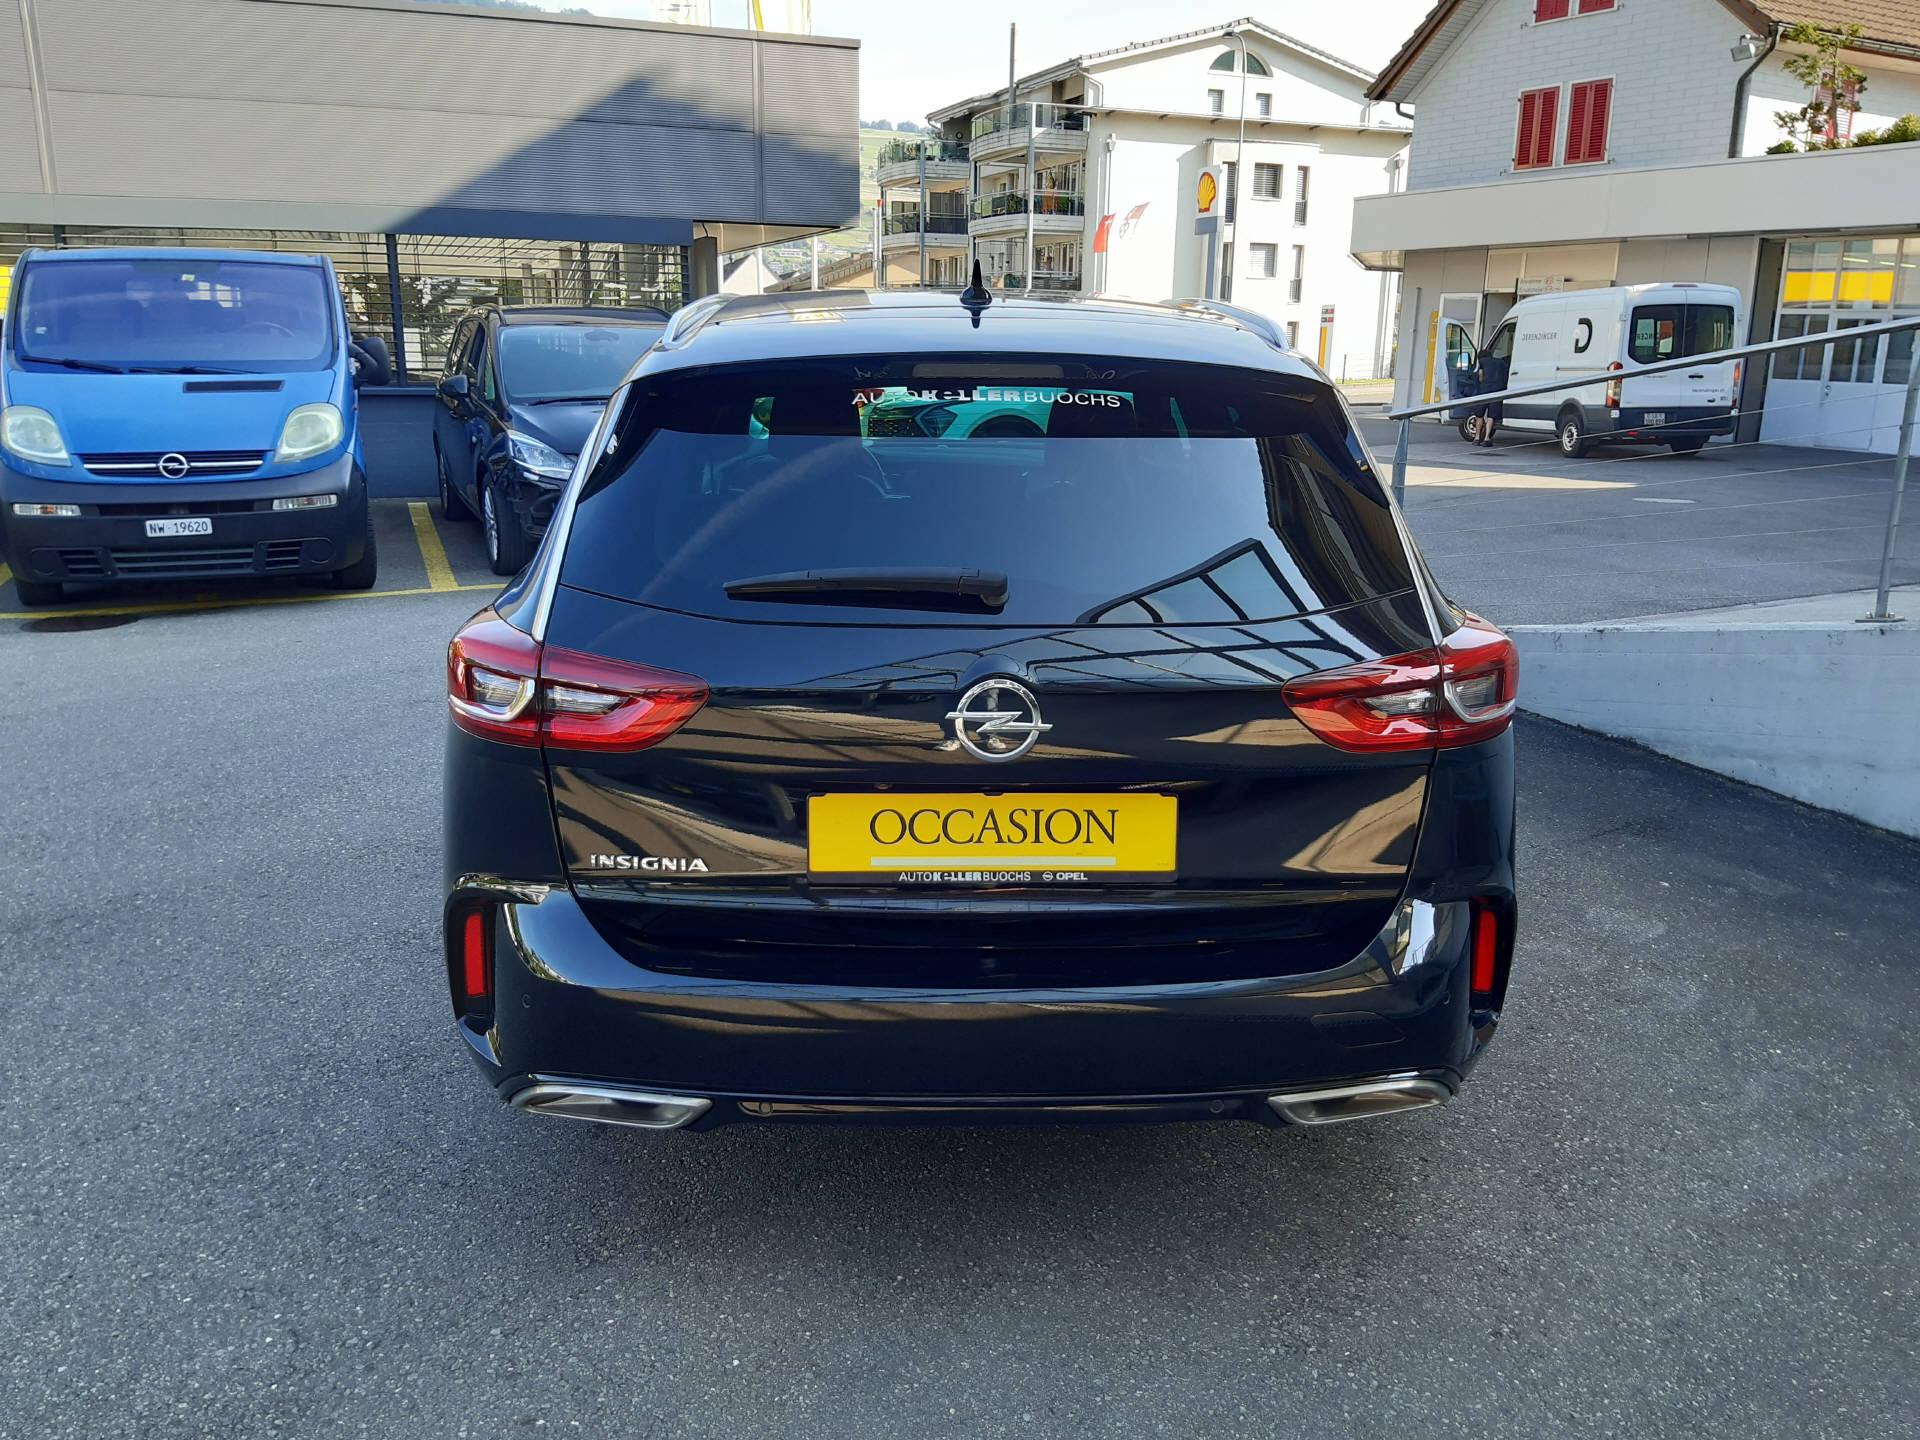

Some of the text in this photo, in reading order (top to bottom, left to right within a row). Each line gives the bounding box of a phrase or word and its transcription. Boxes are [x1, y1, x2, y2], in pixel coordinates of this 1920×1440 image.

[149, 521, 208, 534] NW 19620
[869, 808, 1119, 845] OCCASION
[590, 854, 709, 872] INSIGNIA
[1056, 872, 1088, 881] OPEL
